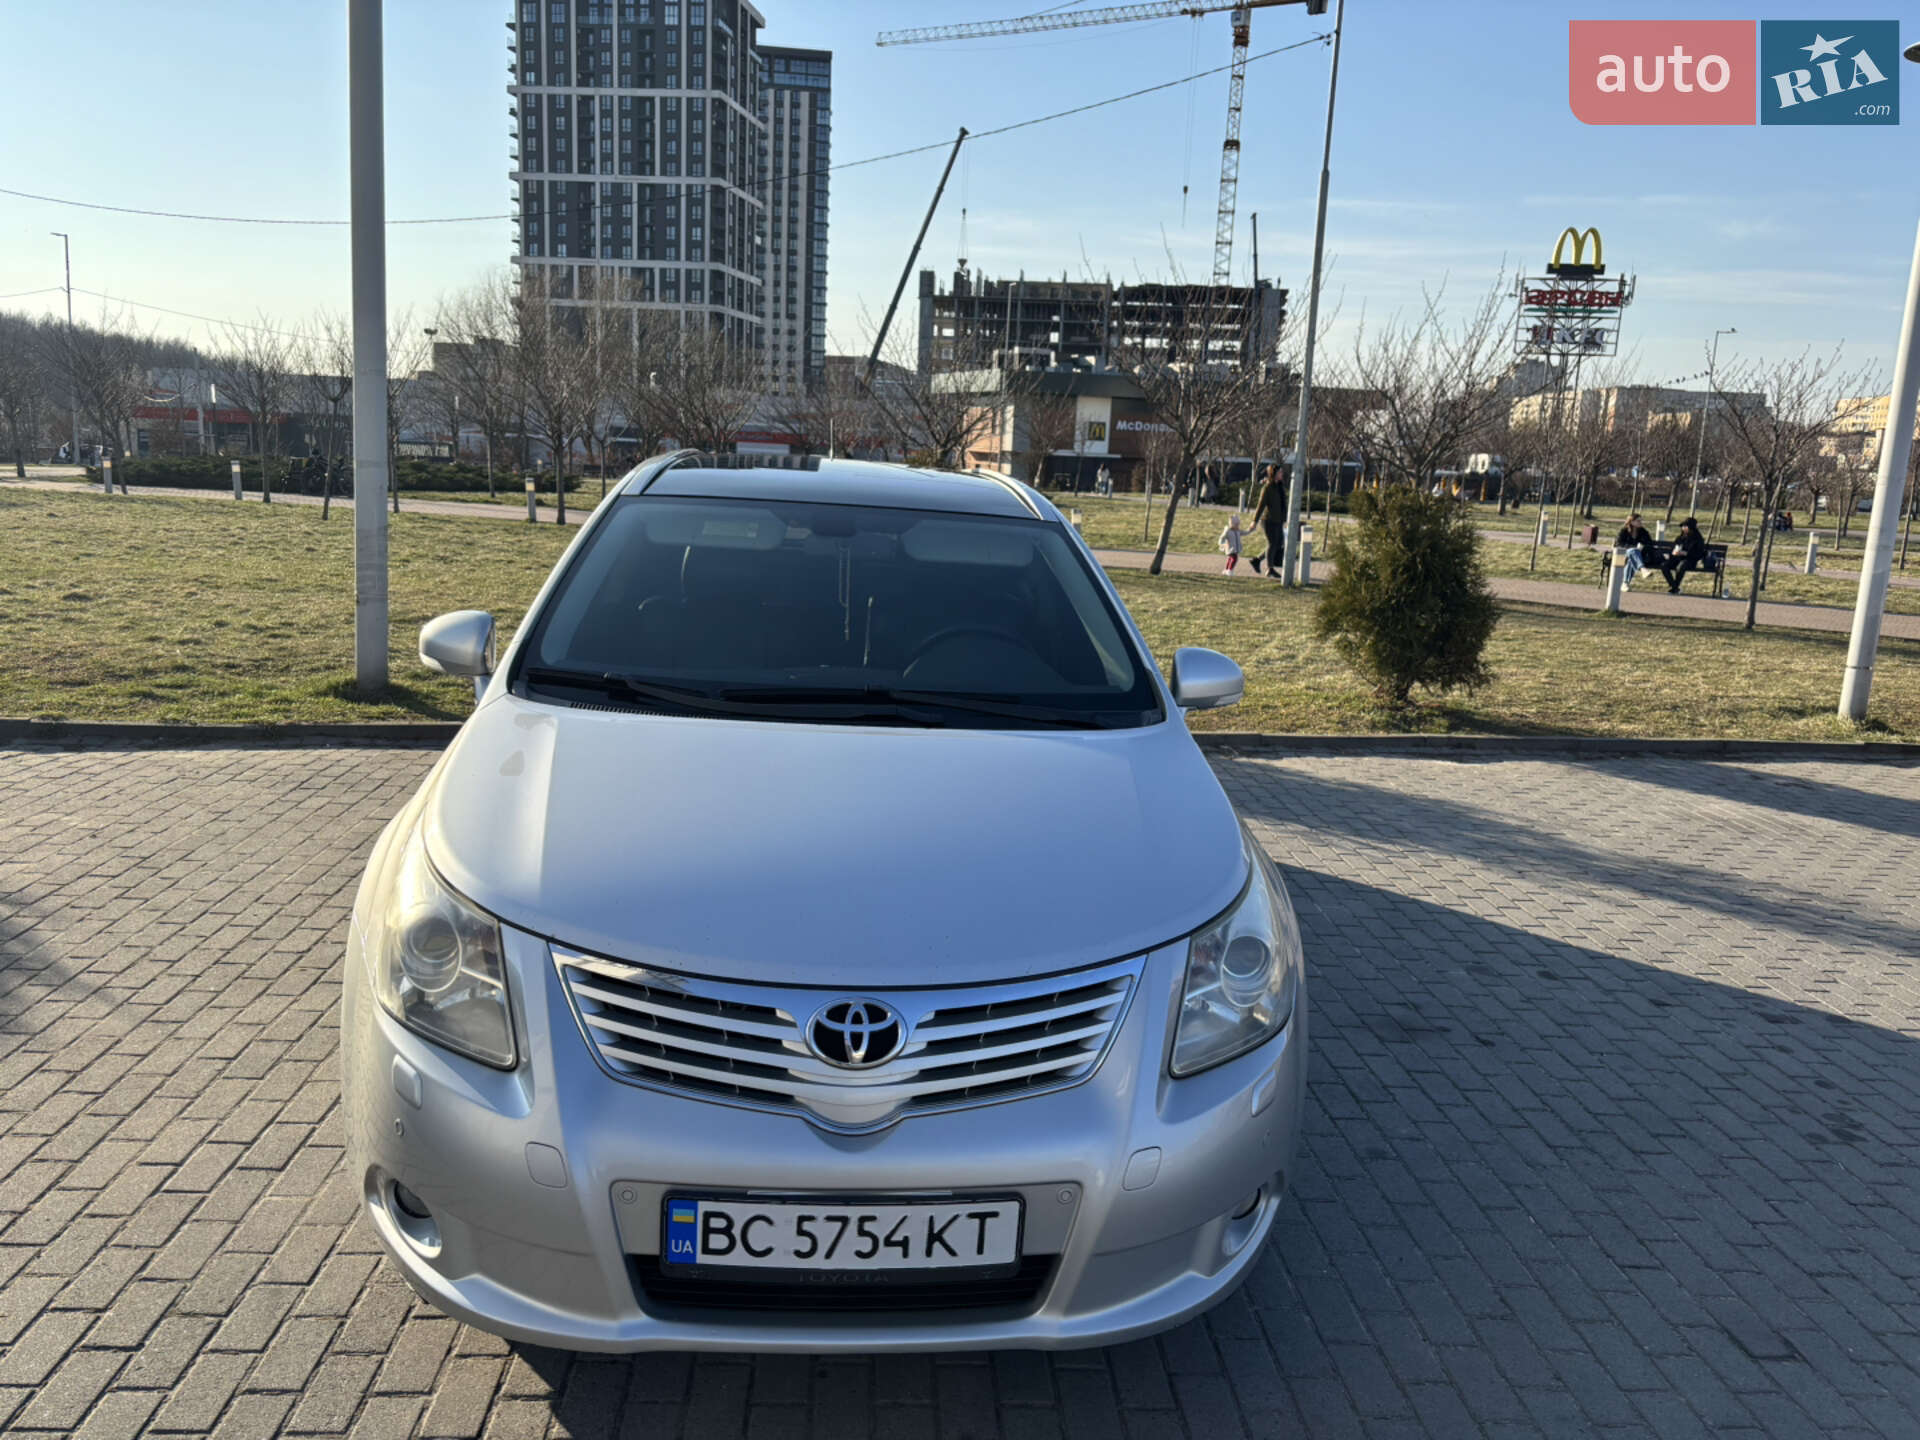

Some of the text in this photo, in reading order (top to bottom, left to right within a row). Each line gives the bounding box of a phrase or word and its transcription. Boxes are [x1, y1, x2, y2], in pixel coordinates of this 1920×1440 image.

[671, 1239, 694, 1254] UA
[701, 1210, 1000, 1260] BC 5754 KT
